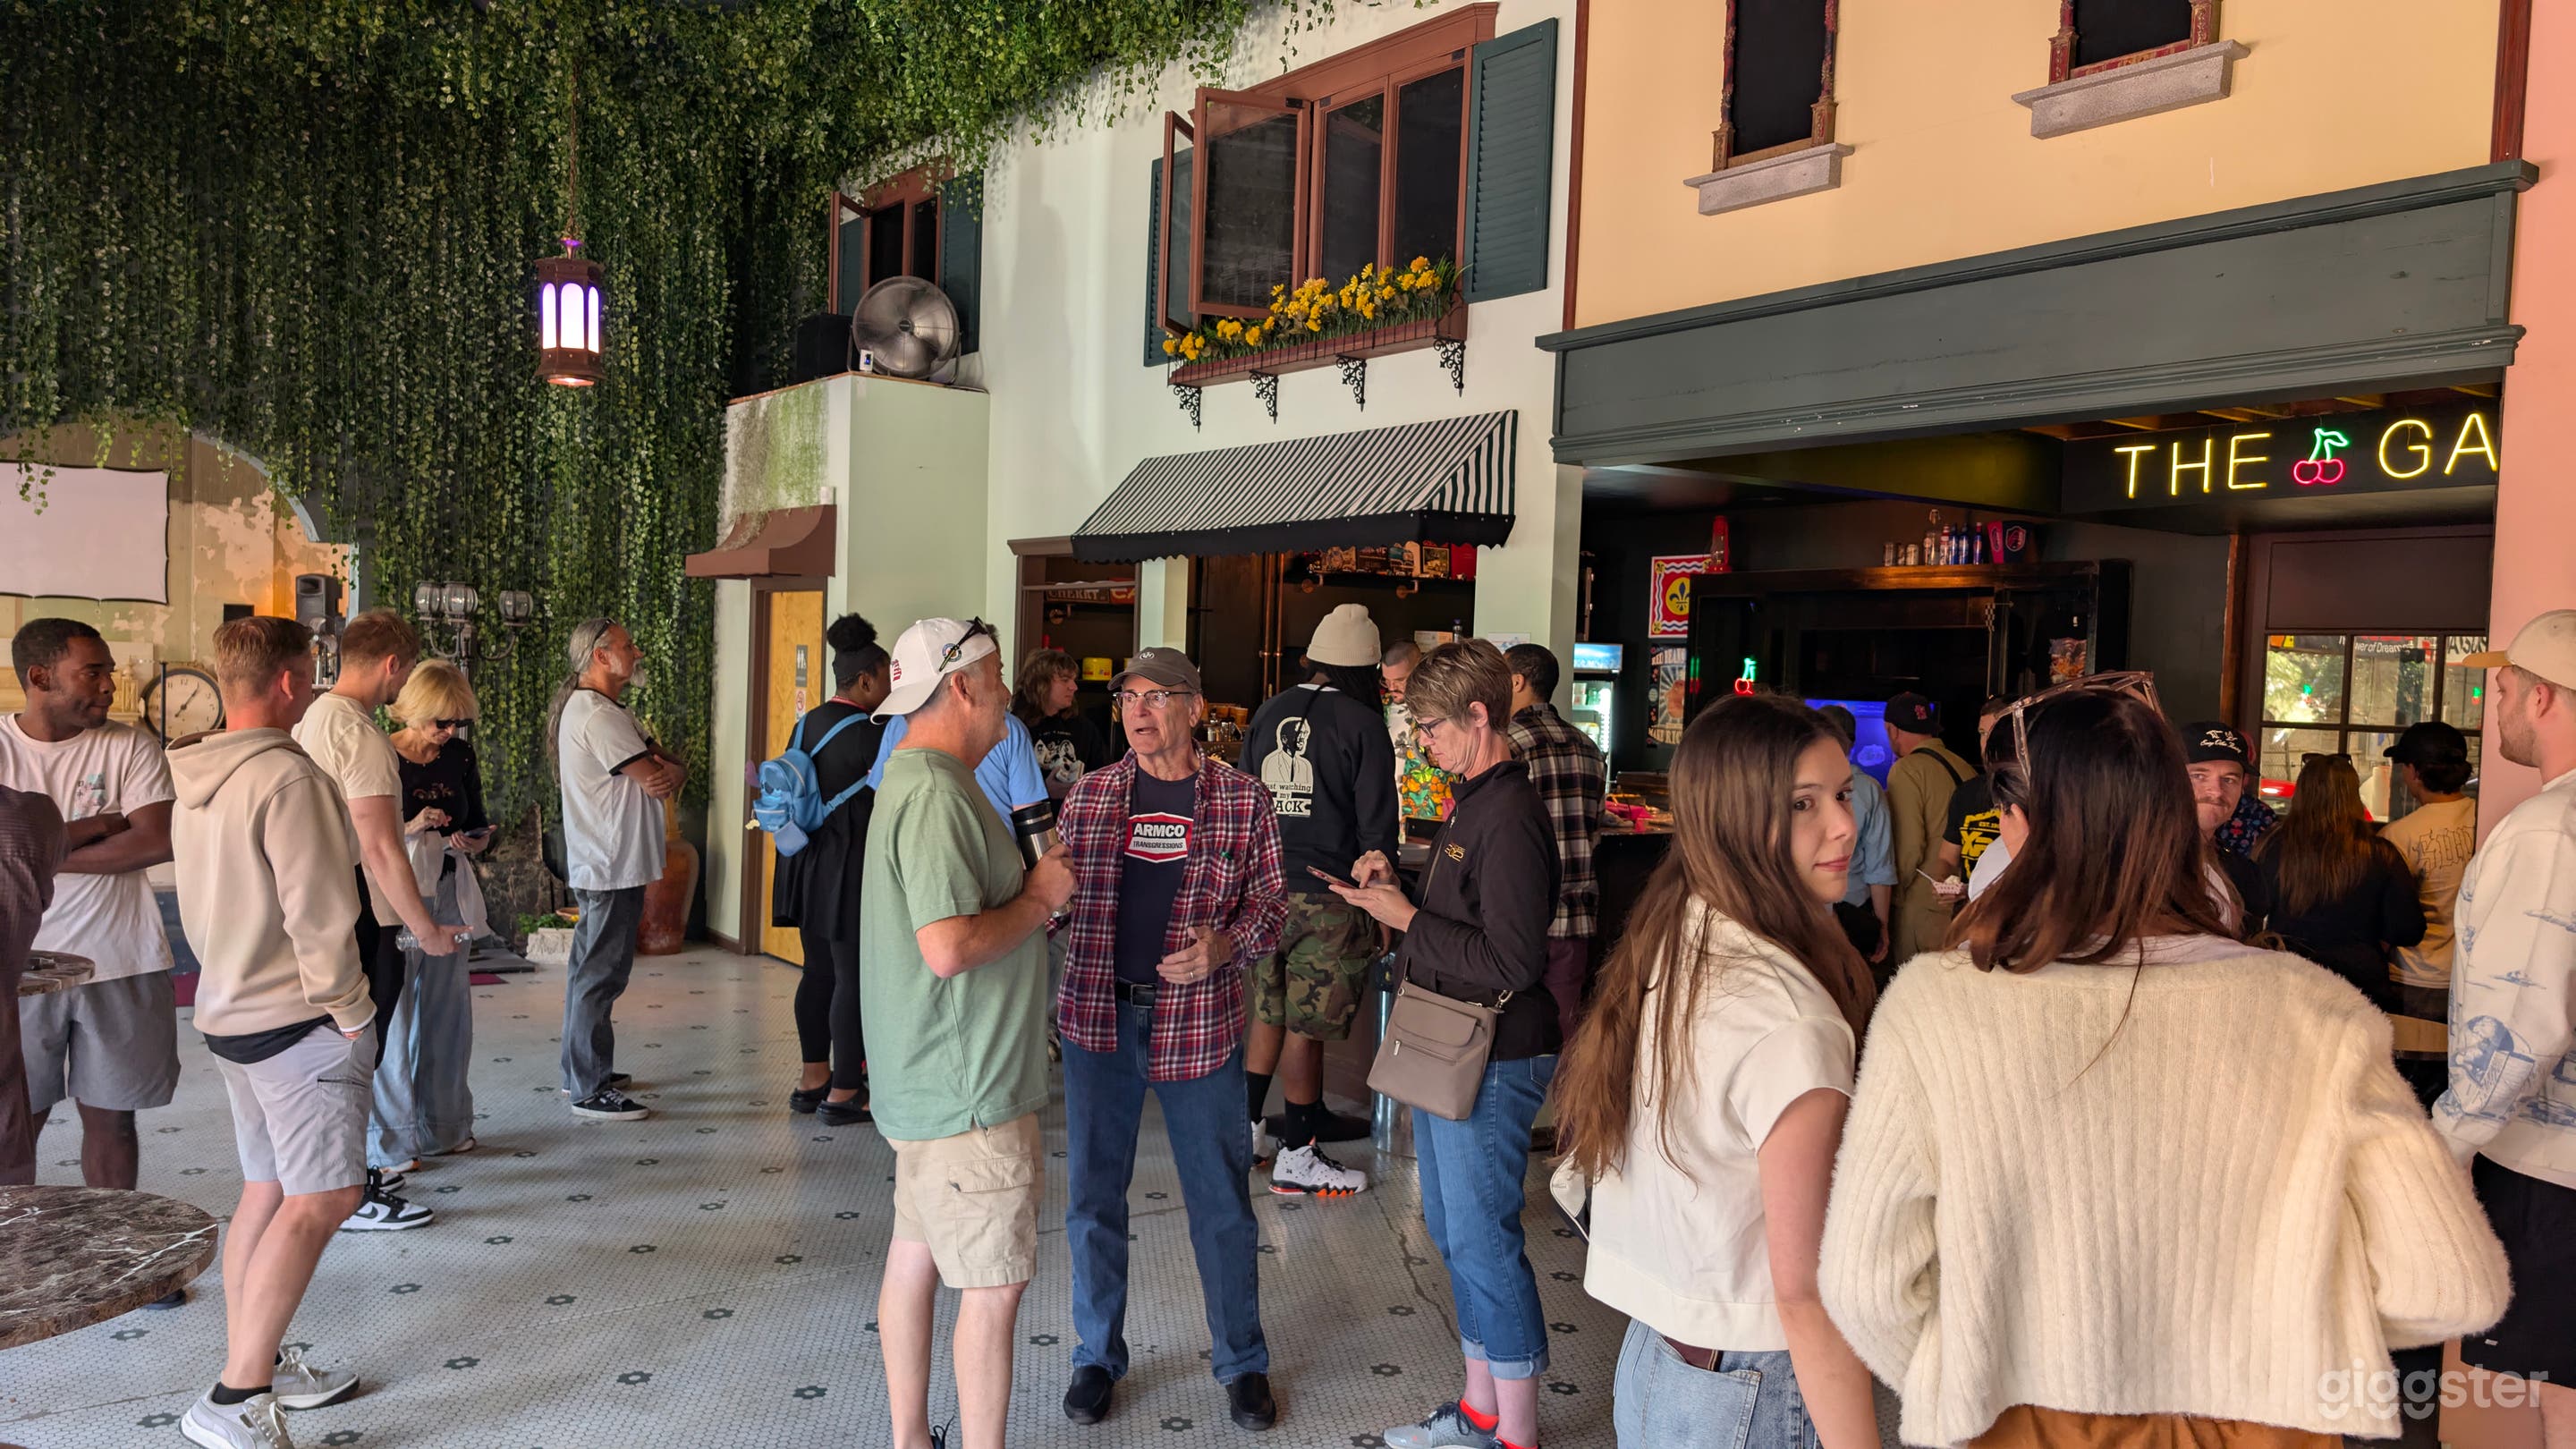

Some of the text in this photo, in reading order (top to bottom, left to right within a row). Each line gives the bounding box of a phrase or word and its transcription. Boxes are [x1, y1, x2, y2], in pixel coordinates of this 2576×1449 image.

[2114, 412, 2497, 500] THE GA
[1133, 823, 1185, 837] ARMCO
